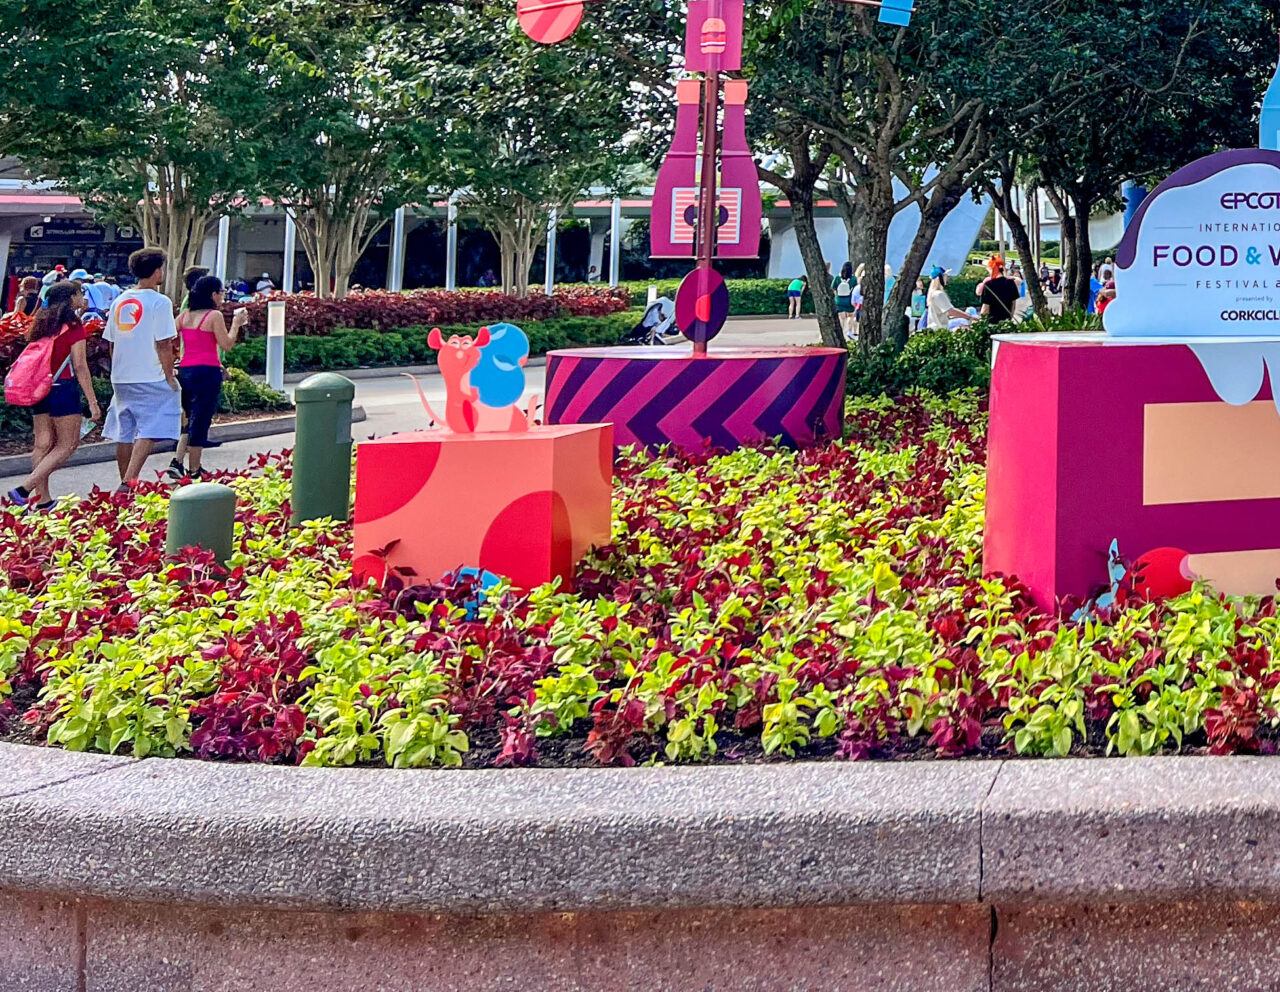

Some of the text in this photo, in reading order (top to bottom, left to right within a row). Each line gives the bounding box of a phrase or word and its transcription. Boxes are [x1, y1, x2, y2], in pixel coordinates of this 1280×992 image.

[1153, 245, 1239, 267] FOOD
[1245, 246, 1262, 265] &
[1196, 279, 1268, 289] FESTIVAL
[1266, 295, 1273, 303] by
